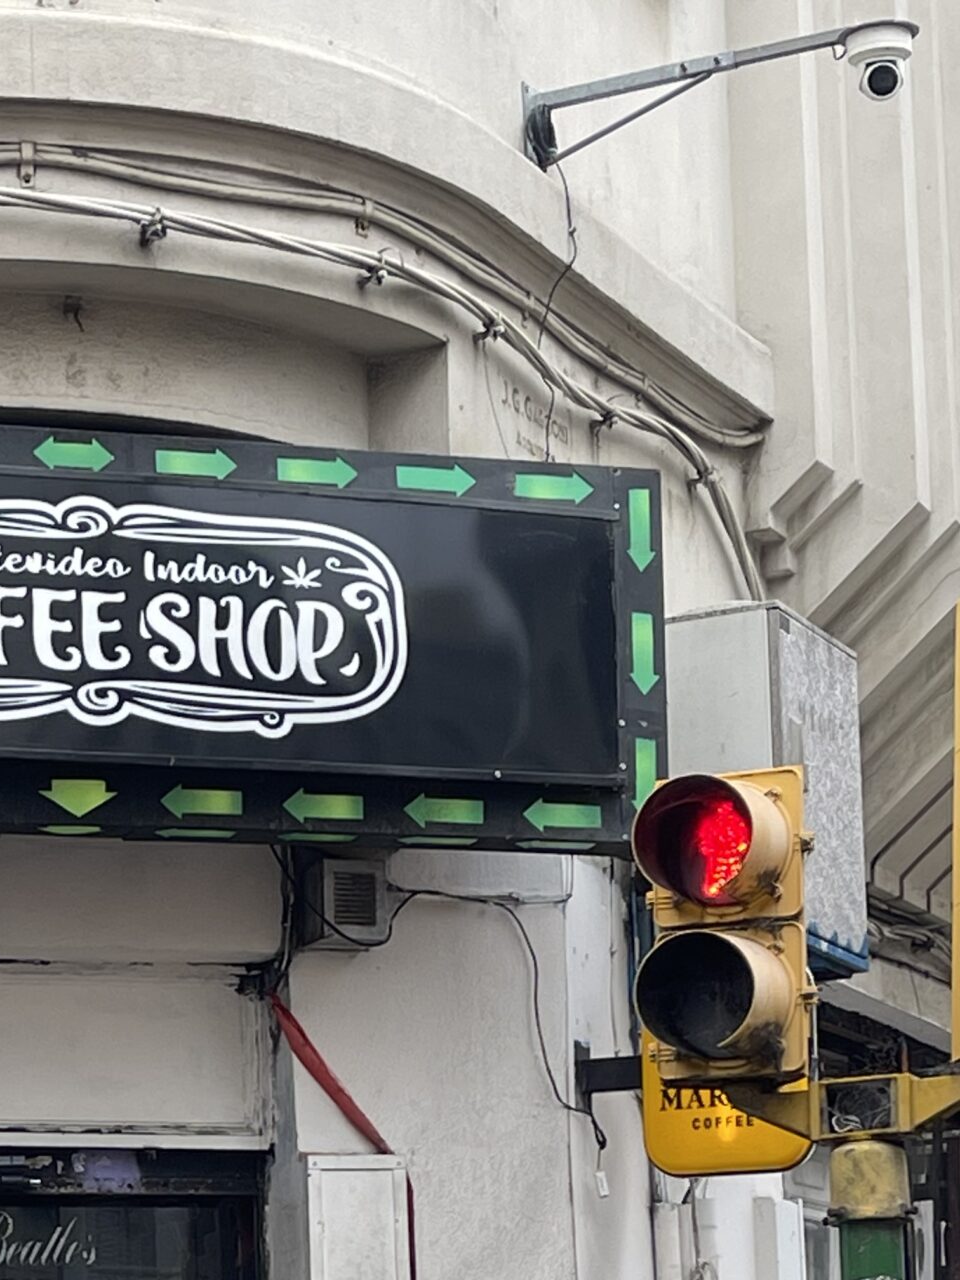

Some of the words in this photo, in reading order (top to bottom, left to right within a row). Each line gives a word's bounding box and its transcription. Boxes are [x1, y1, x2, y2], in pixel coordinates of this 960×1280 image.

[144, 550, 276, 588] Indoor
[139, 592, 362, 686] SHOP
[659, 1088, 735, 1112] MAR
[691, 1114, 755, 1131] COFFEE
